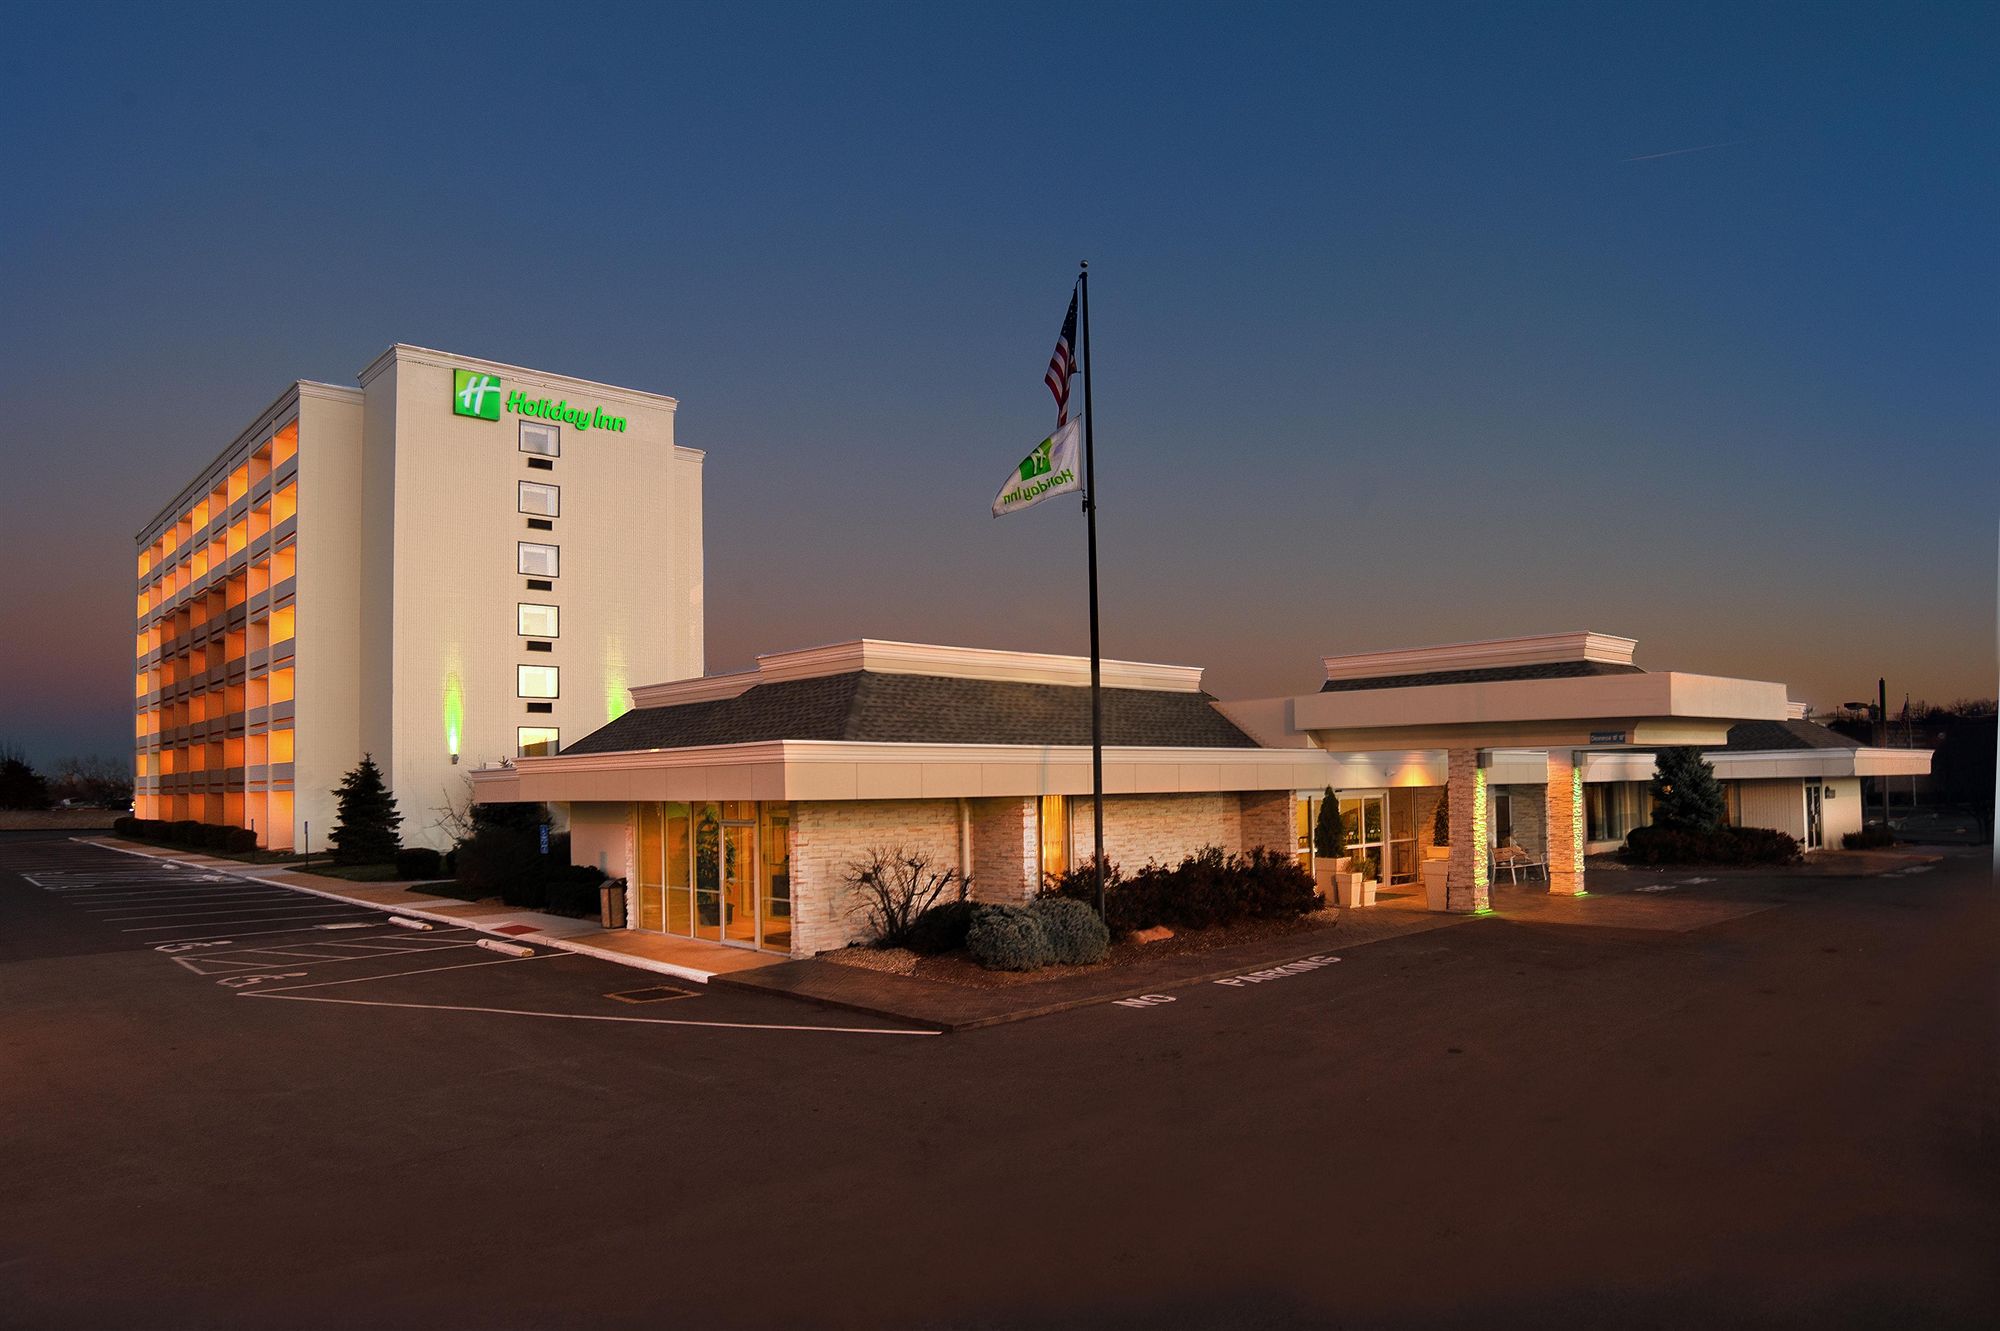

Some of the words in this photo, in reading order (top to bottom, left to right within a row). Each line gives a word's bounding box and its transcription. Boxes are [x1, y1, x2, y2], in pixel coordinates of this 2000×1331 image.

[506, 389, 592, 431] Holiday
[593, 405, 627, 433] Inn
[1112, 994, 1177, 1009] NO
[1213, 955, 1342, 987] PARKING
